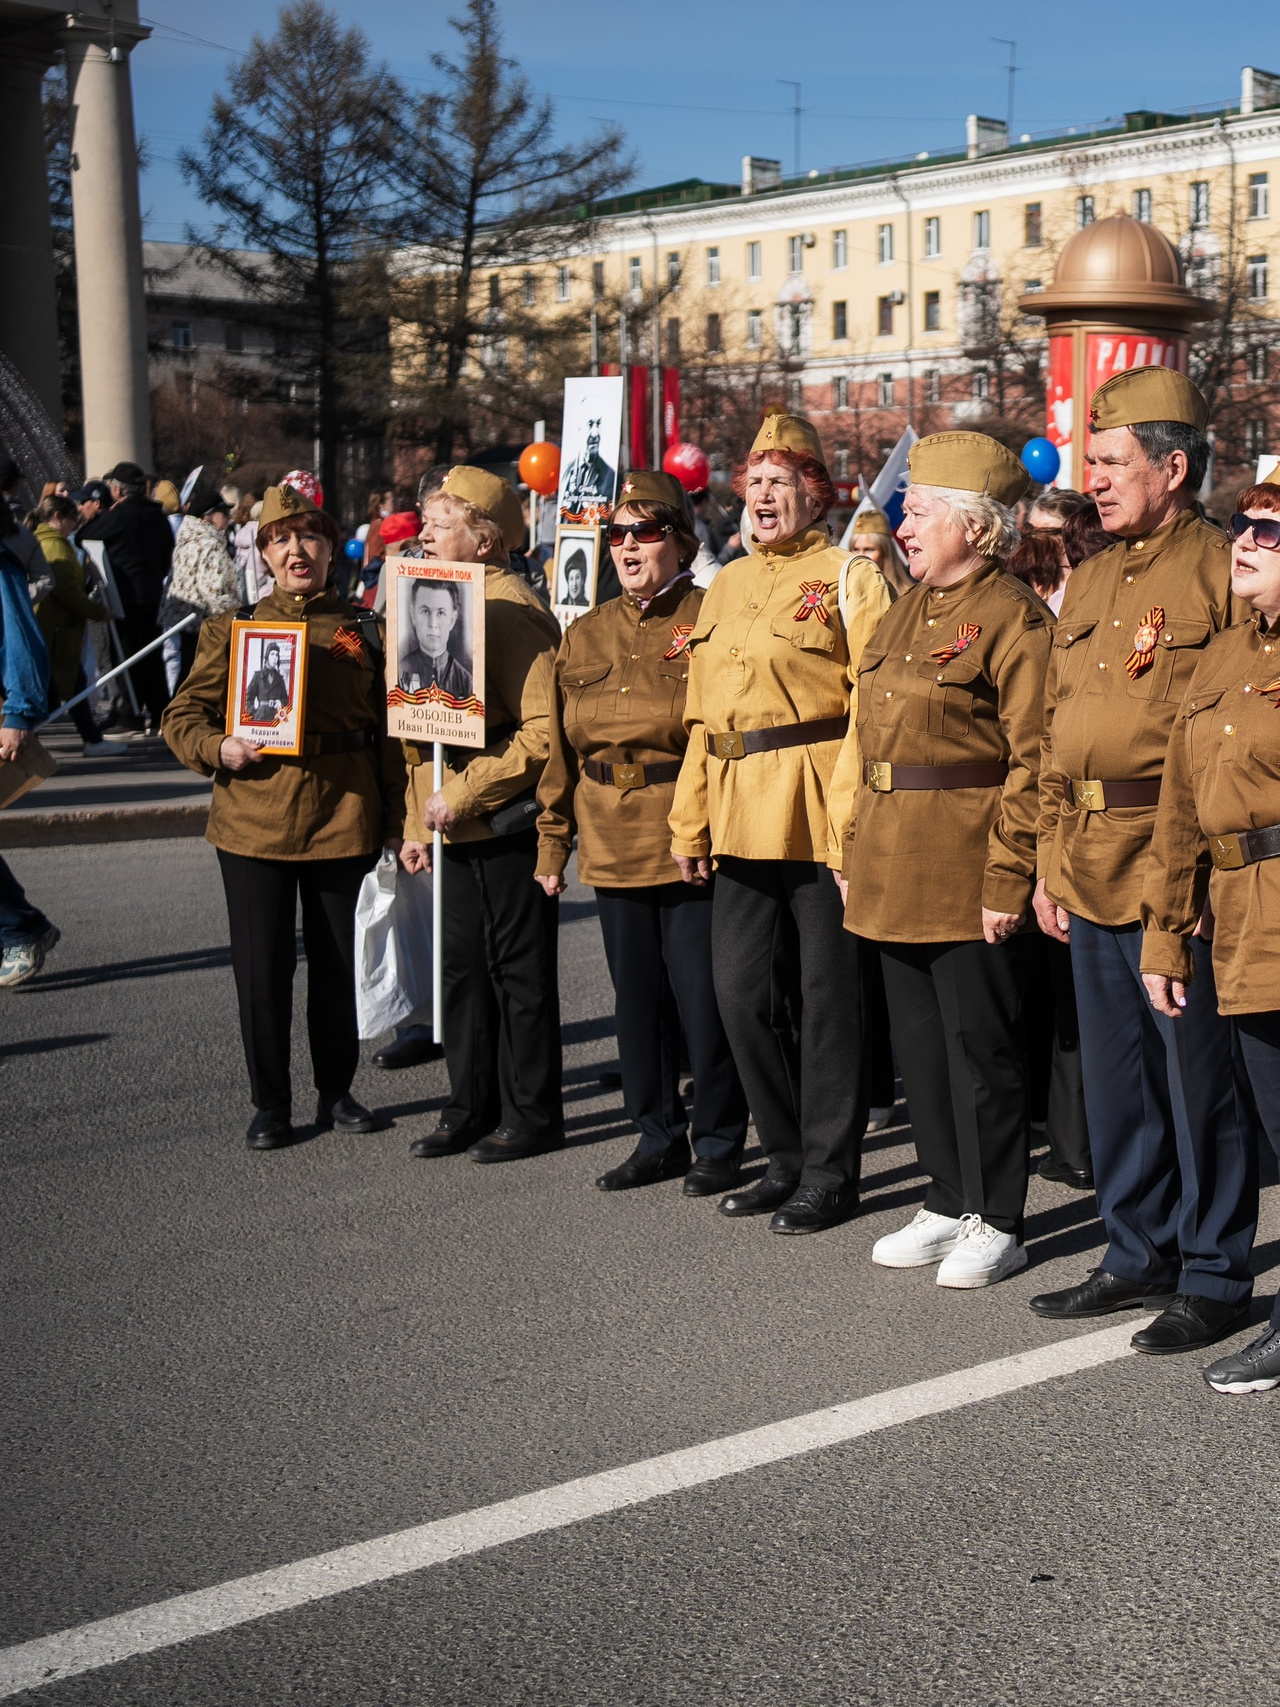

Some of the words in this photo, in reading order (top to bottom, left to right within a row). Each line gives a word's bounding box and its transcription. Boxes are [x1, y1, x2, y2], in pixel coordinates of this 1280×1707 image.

[407, 566, 454, 579] БЕССМЕРТНЫЙ
[455, 570, 472, 580] ПОЛК
[410, 707, 463, 724] ЗОБОЛЕВ
[398, 719, 423, 733] Иван
[426, 723, 476, 740] Павлович
